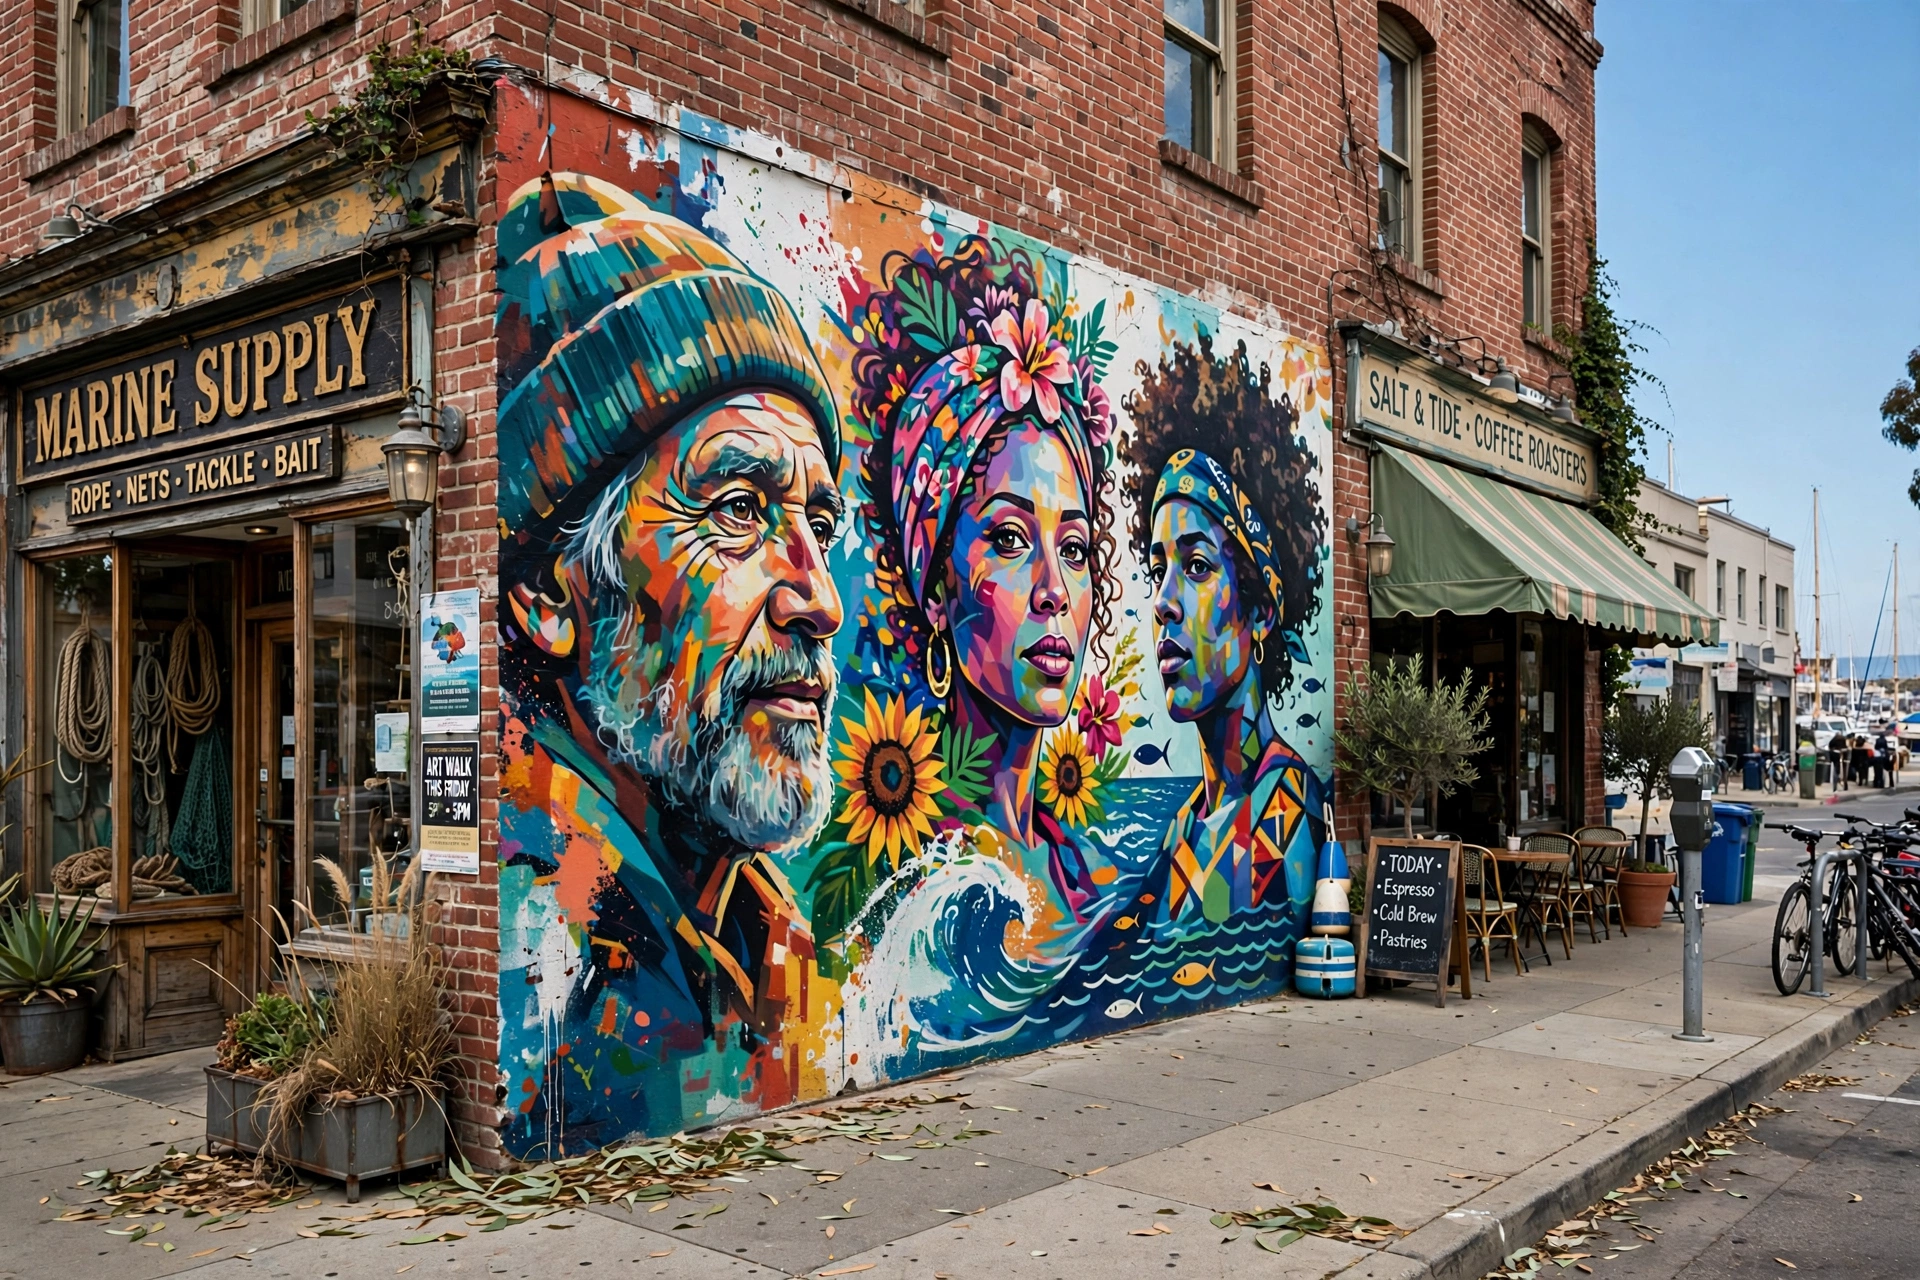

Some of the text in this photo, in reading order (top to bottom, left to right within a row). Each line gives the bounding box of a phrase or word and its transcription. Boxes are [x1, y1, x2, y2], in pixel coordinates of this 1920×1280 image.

[35, 298, 375, 463] MARINE SUPPLY
[1370, 370, 1587, 486] SALT & TIDE COFFEE ROASTERS
[71, 436, 322, 515] ROPE NETS TACKLE BAIT
[426, 756, 472, 776] ART WALK
[424, 779, 470, 797] THIS FRIDAY
[452, 802, 471, 821] 5PM
[1389, 854, 1434, 874] TODAY
[1384, 878, 1435, 901] Espresso
[1380, 903, 1437, 923] Cold Brew
[1380, 928, 1427, 950] Pastries
